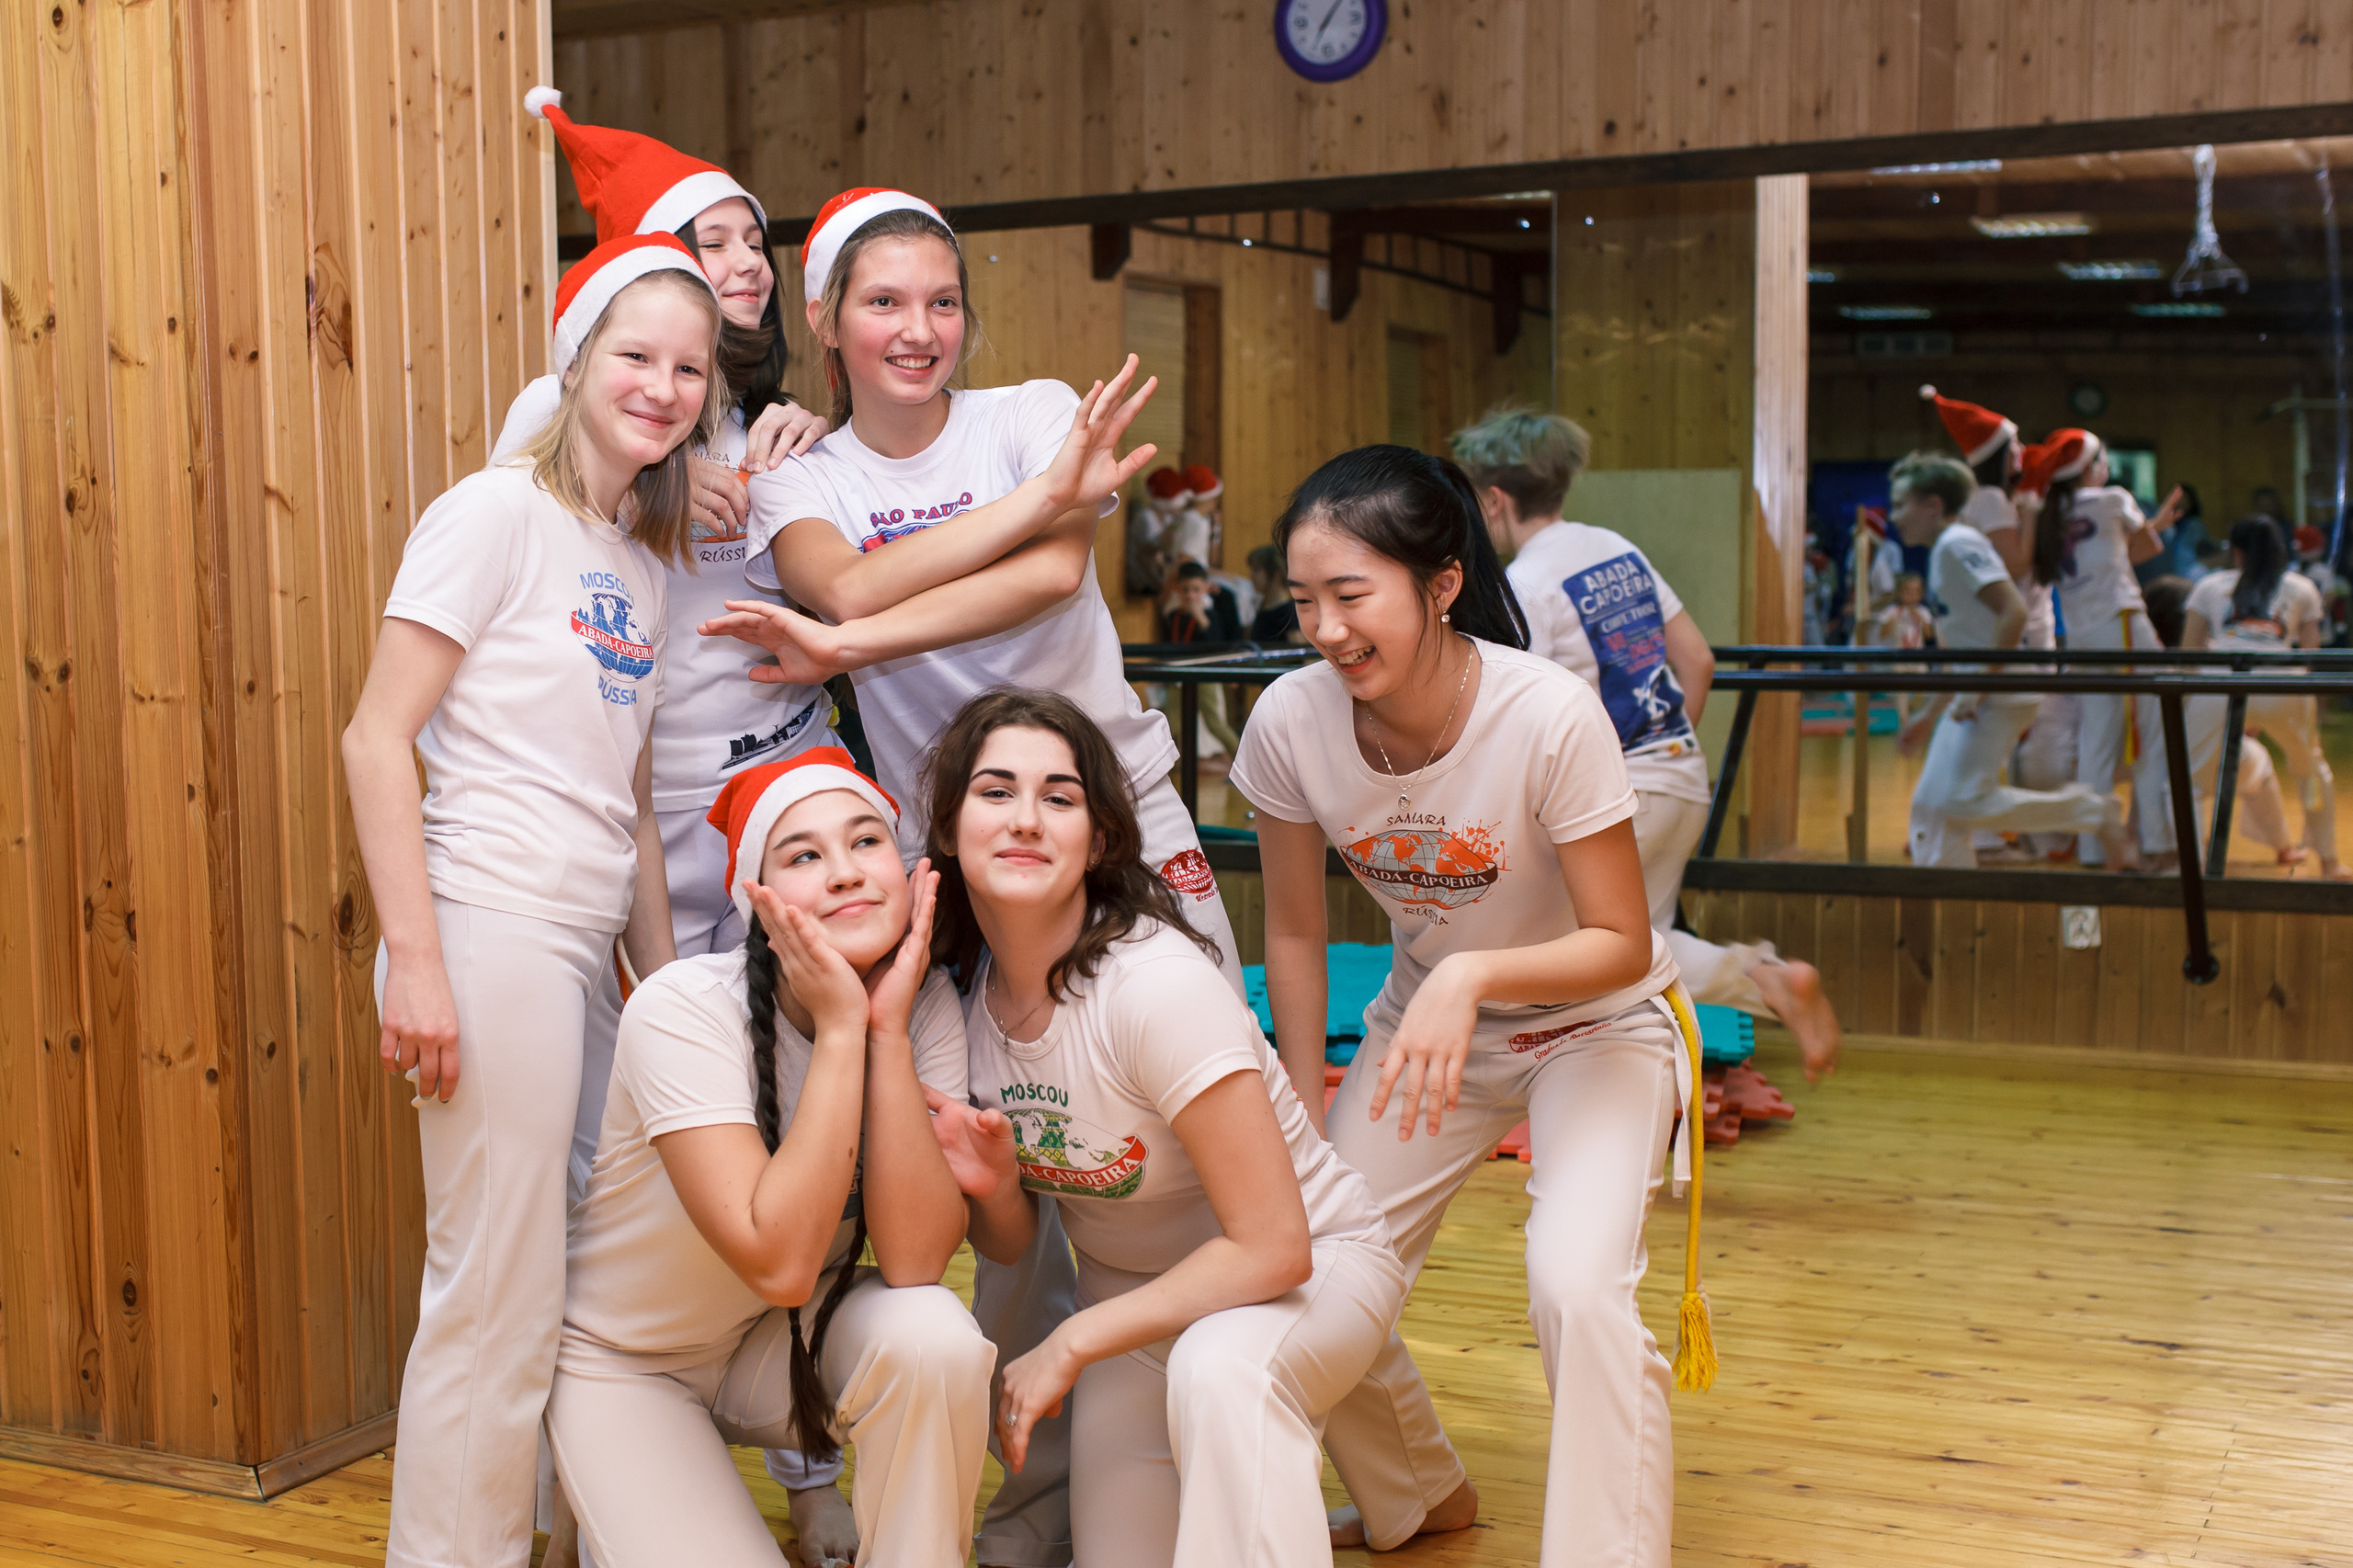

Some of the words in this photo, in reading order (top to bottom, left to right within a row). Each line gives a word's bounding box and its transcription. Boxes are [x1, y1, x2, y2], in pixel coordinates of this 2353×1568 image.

[699, 545, 746, 563] RÚSSI
[579, 572, 635, 607] MOSCO
[577, 624, 654, 659] ABADÁ-CAPOEIRA
[1386, 812, 1446, 827] SAMARA
[1350, 860, 1488, 888] ABADÁ-CAPOEIRA
[1000, 1083, 1069, 1108] MOSCOU
